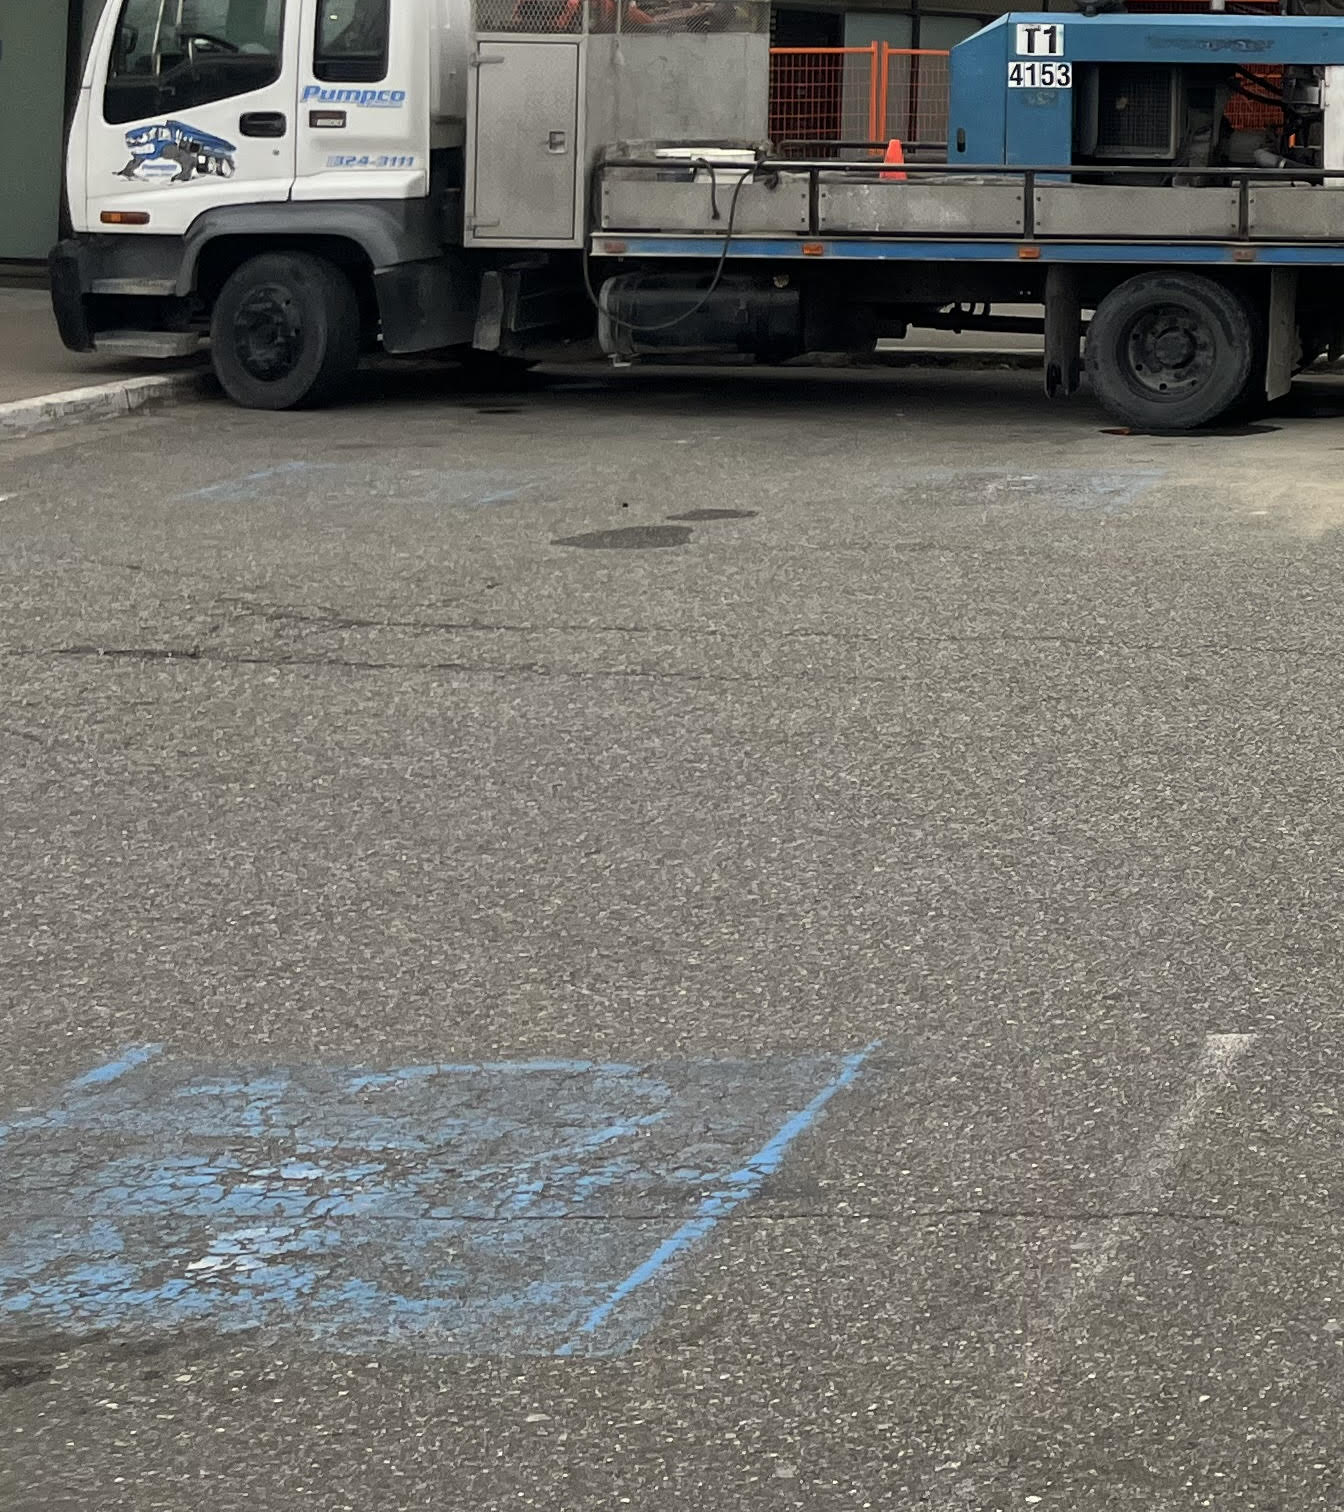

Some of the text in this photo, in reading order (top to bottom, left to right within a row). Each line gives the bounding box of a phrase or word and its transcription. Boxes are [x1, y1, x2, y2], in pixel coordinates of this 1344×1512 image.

[1023, 25, 1057, 55] T1
[1009, 63, 1071, 86] 4153
[303, 85, 406, 104] Pumpco
